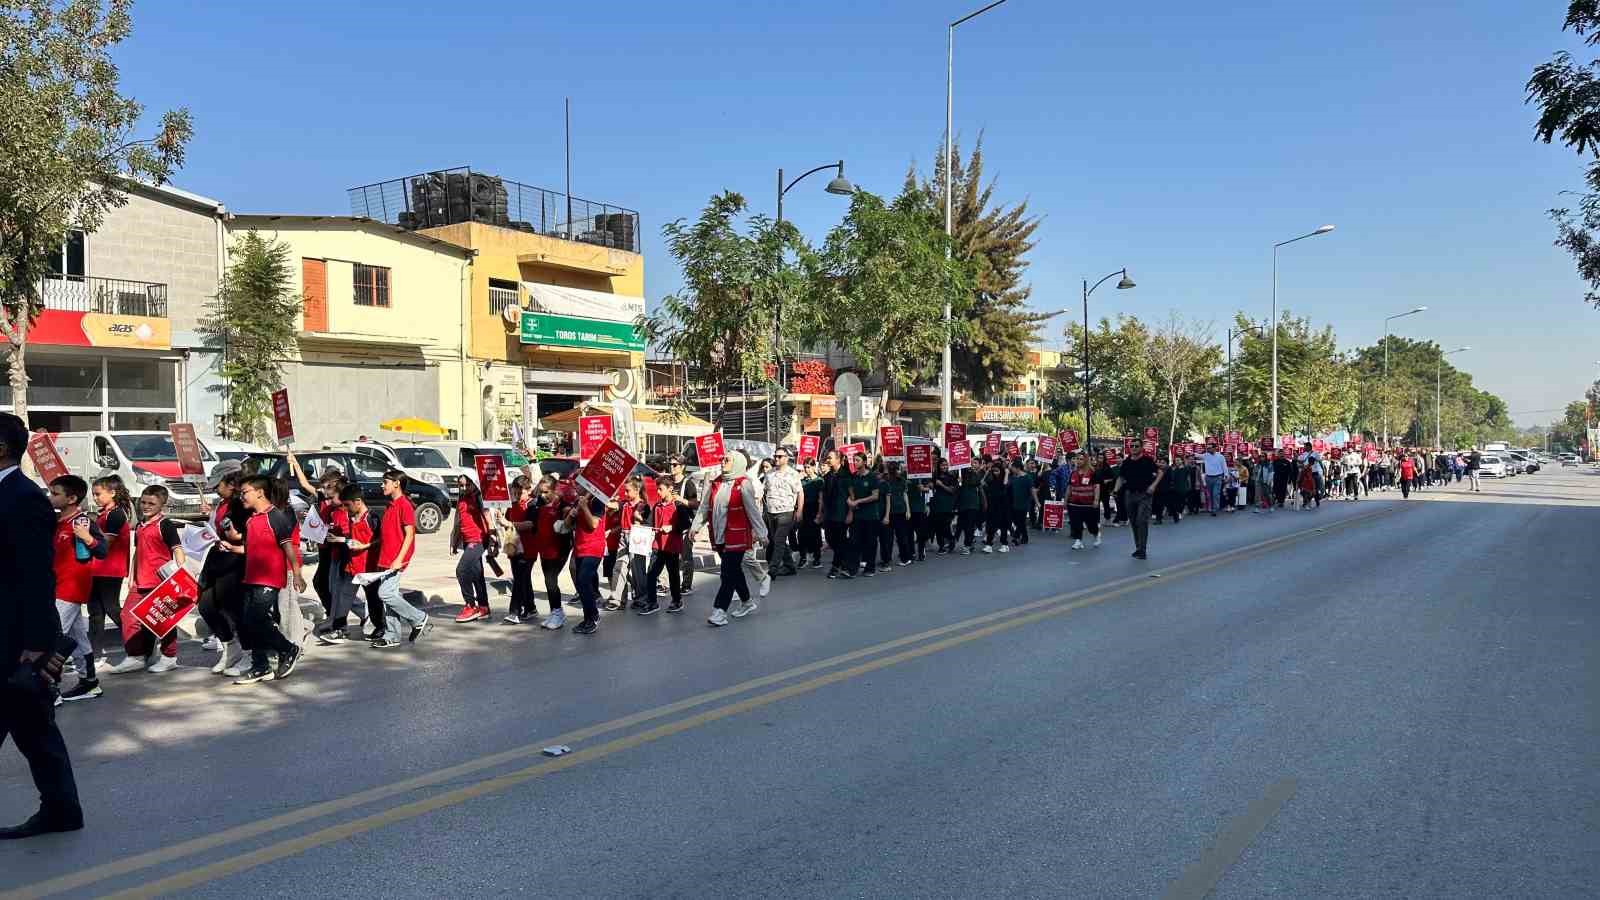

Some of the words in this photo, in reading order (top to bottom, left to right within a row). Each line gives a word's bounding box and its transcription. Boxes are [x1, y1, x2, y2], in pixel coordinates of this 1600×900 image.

[108, 323, 134, 333] aras
[555, 330, 577, 341] TOROS
[578, 332, 597, 342] TARIM
